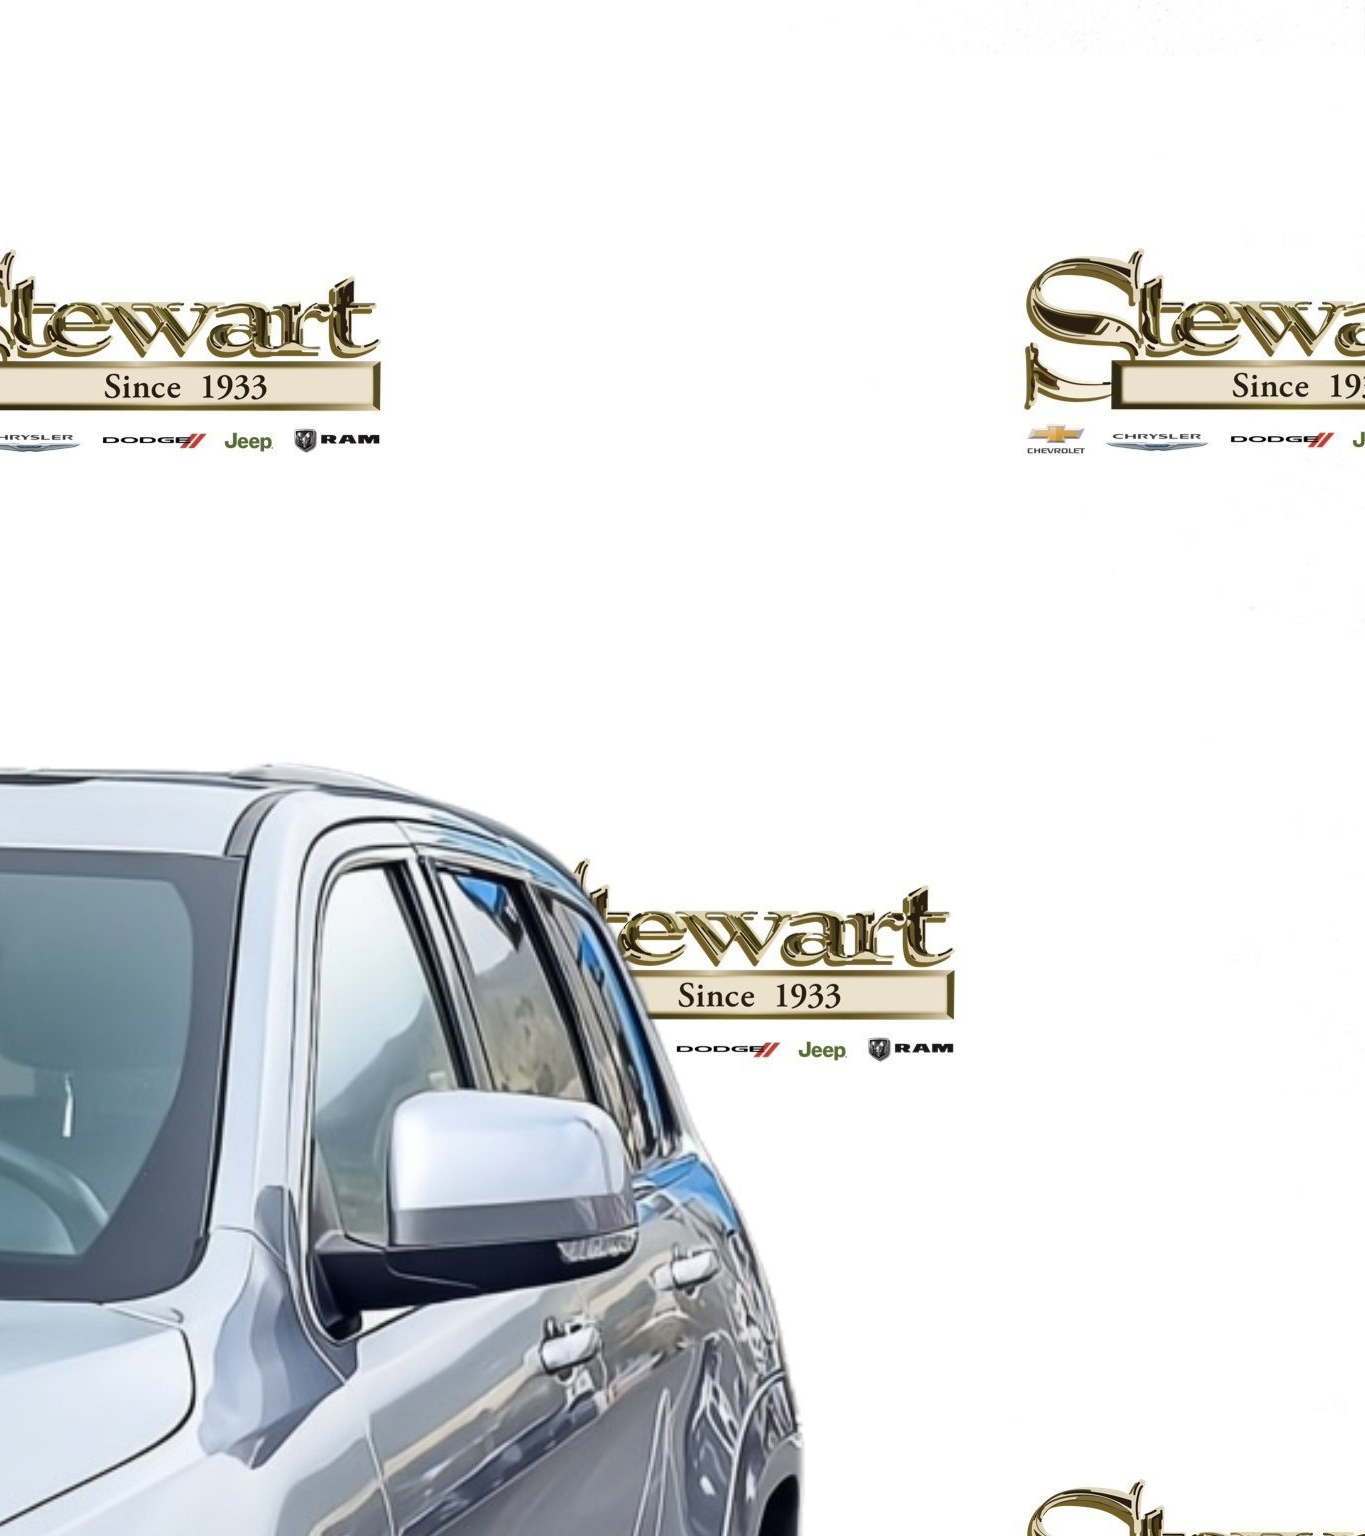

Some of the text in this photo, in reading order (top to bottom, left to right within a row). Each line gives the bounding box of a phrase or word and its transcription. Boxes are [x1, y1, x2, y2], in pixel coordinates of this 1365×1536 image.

[104, 373, 268, 401] Since 1933
[1232, 372, 1365, 400] Since 19
[224, 432, 273, 451] Jeep
[321, 434, 380, 444] RAM
[678, 982, 842, 1010] Since 1933
[798, 1041, 847, 1060] Jeep
[895, 1043, 954, 1053] RAM
